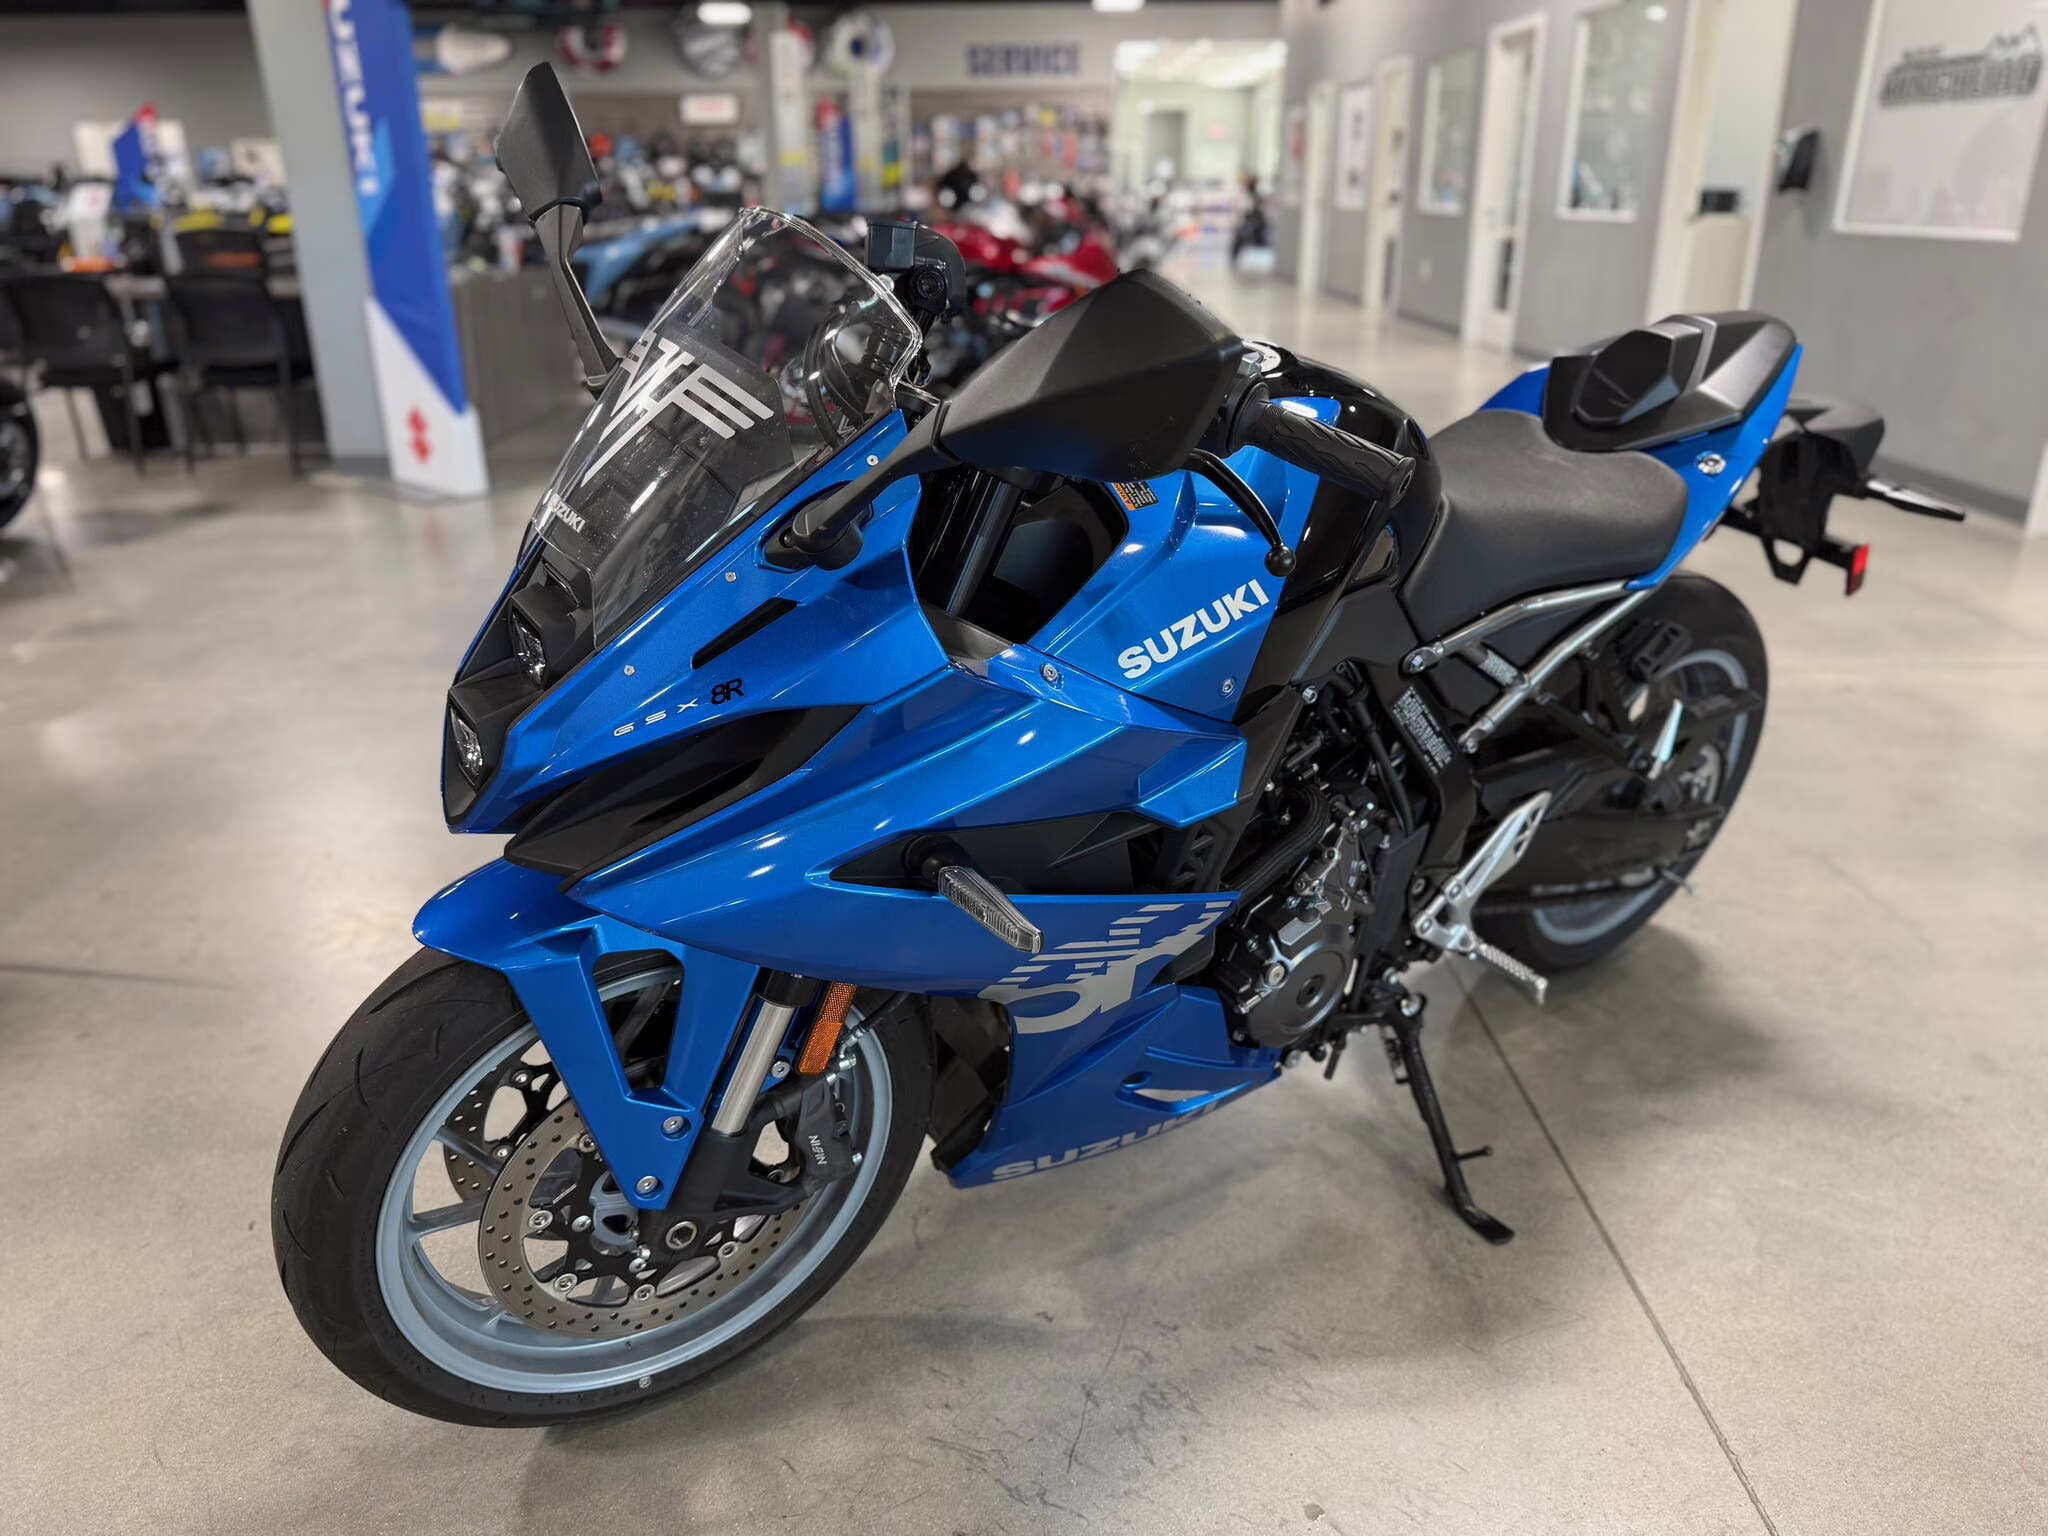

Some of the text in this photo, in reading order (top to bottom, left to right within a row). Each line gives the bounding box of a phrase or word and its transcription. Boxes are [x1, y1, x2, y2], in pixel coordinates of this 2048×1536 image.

[549, 493, 586, 533] UZUKI
[1117, 578, 1270, 680] SUZUKI
[613, 677, 745, 737] GSX 8R
